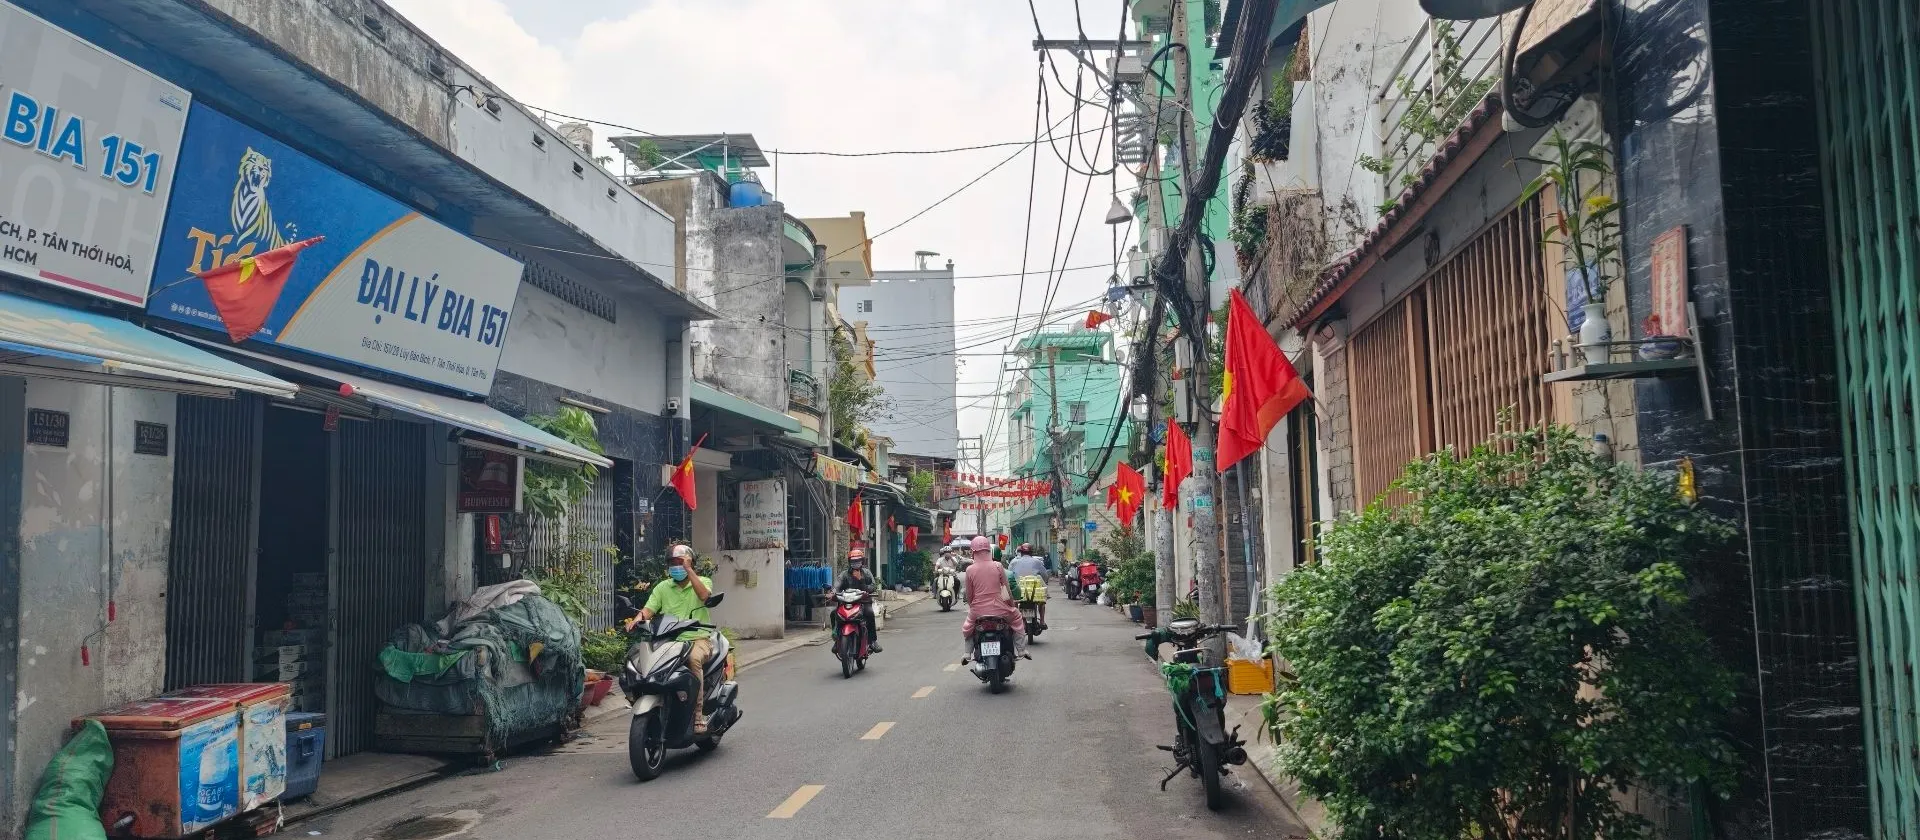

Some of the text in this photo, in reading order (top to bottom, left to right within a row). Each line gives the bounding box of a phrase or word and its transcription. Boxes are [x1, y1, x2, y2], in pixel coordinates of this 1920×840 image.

[2, 90, 161, 194] BIA 151
[0, 219, 134, 274] CH, P. TÂN THỚI HOÀ,
[3, 244, 38, 266] HCM
[356, 258, 508, 348] ĐẠI LÝ BIA 151
[33, 411, 66, 428] 151/30
[464, 497, 511, 508] BUDWEISER
